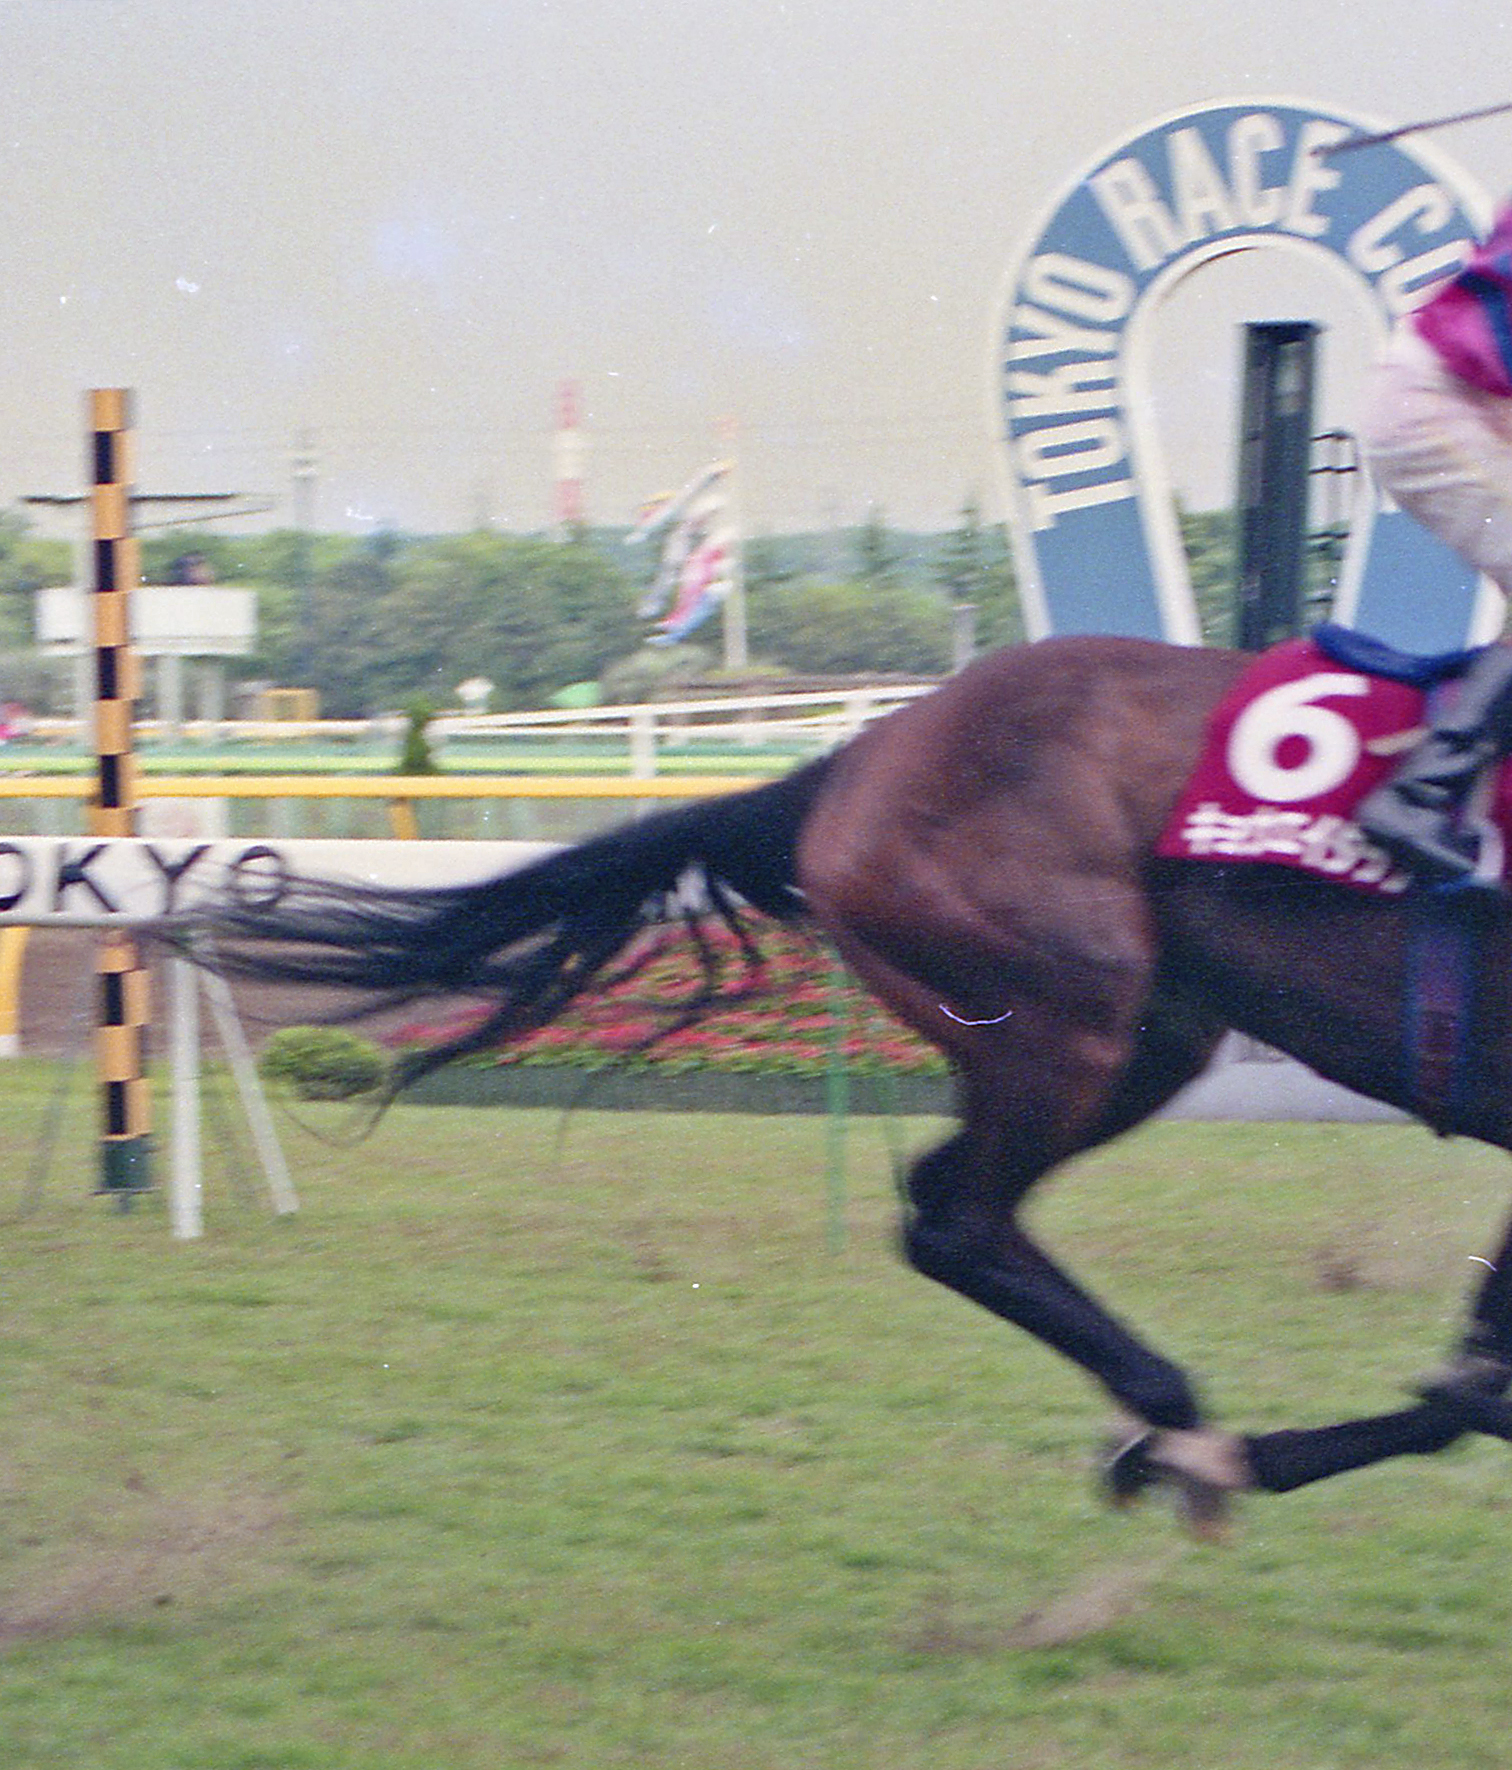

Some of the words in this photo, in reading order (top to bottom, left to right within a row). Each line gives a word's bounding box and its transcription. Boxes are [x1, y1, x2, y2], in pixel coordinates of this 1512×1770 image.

[1006, 252, 1138, 531] TOKYO
[1088, 113, 1350, 271] RACE
[1226, 672, 1371, 803] 6
